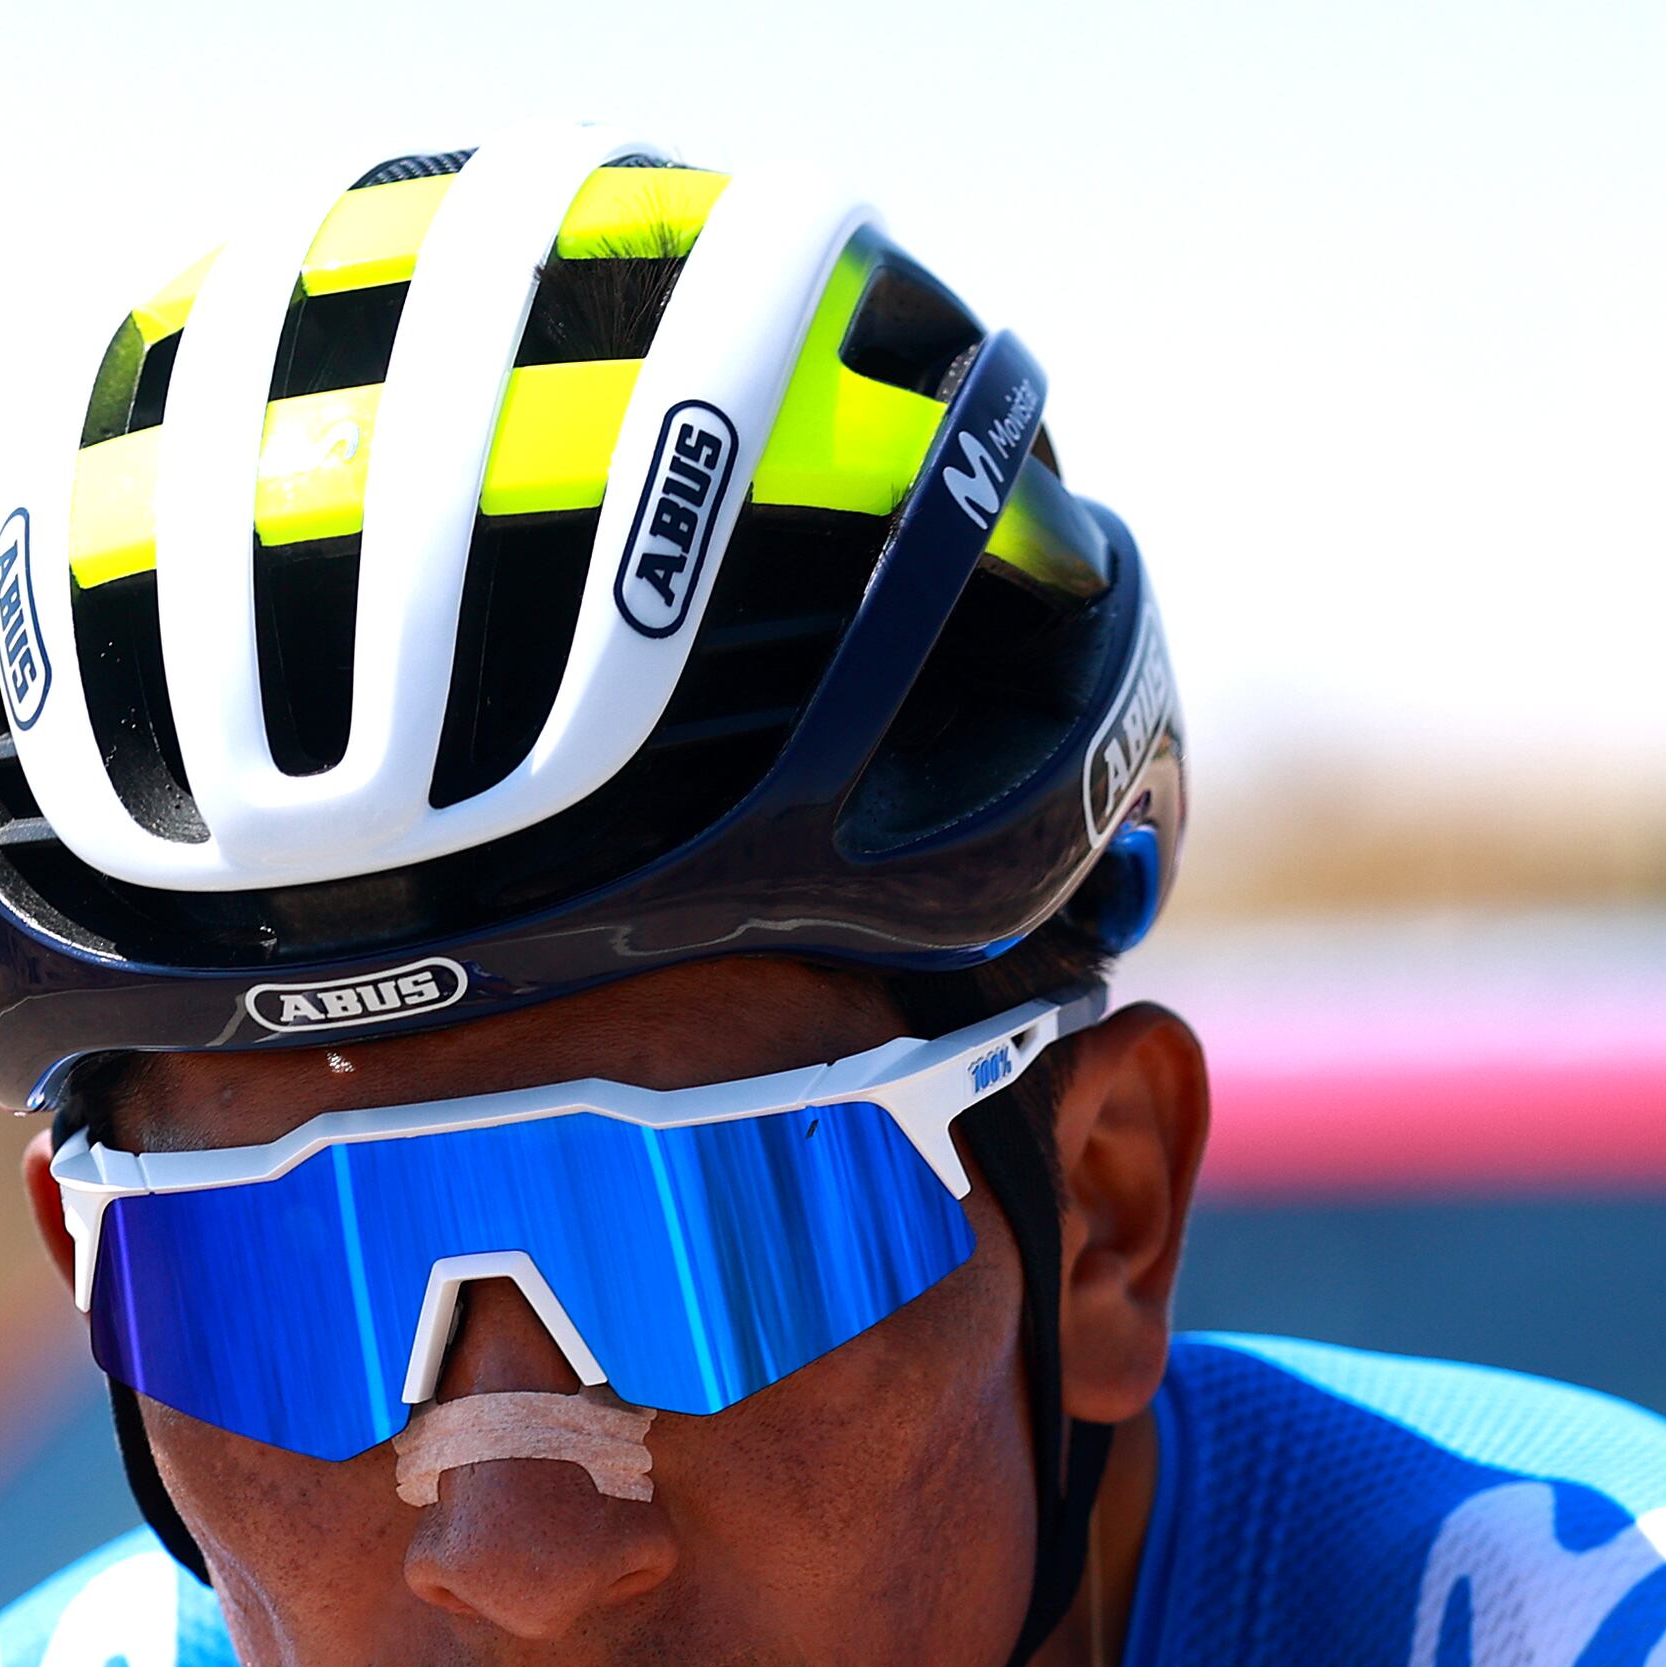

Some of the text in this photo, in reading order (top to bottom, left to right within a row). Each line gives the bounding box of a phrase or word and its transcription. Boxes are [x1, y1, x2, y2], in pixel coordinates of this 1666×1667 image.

[636, 423, 722, 607] ABUS
[1104, 622, 1171, 819] ABUS
[280, 970, 440, 1022] ABUS
[969, 1046, 1012, 1093] 100%
